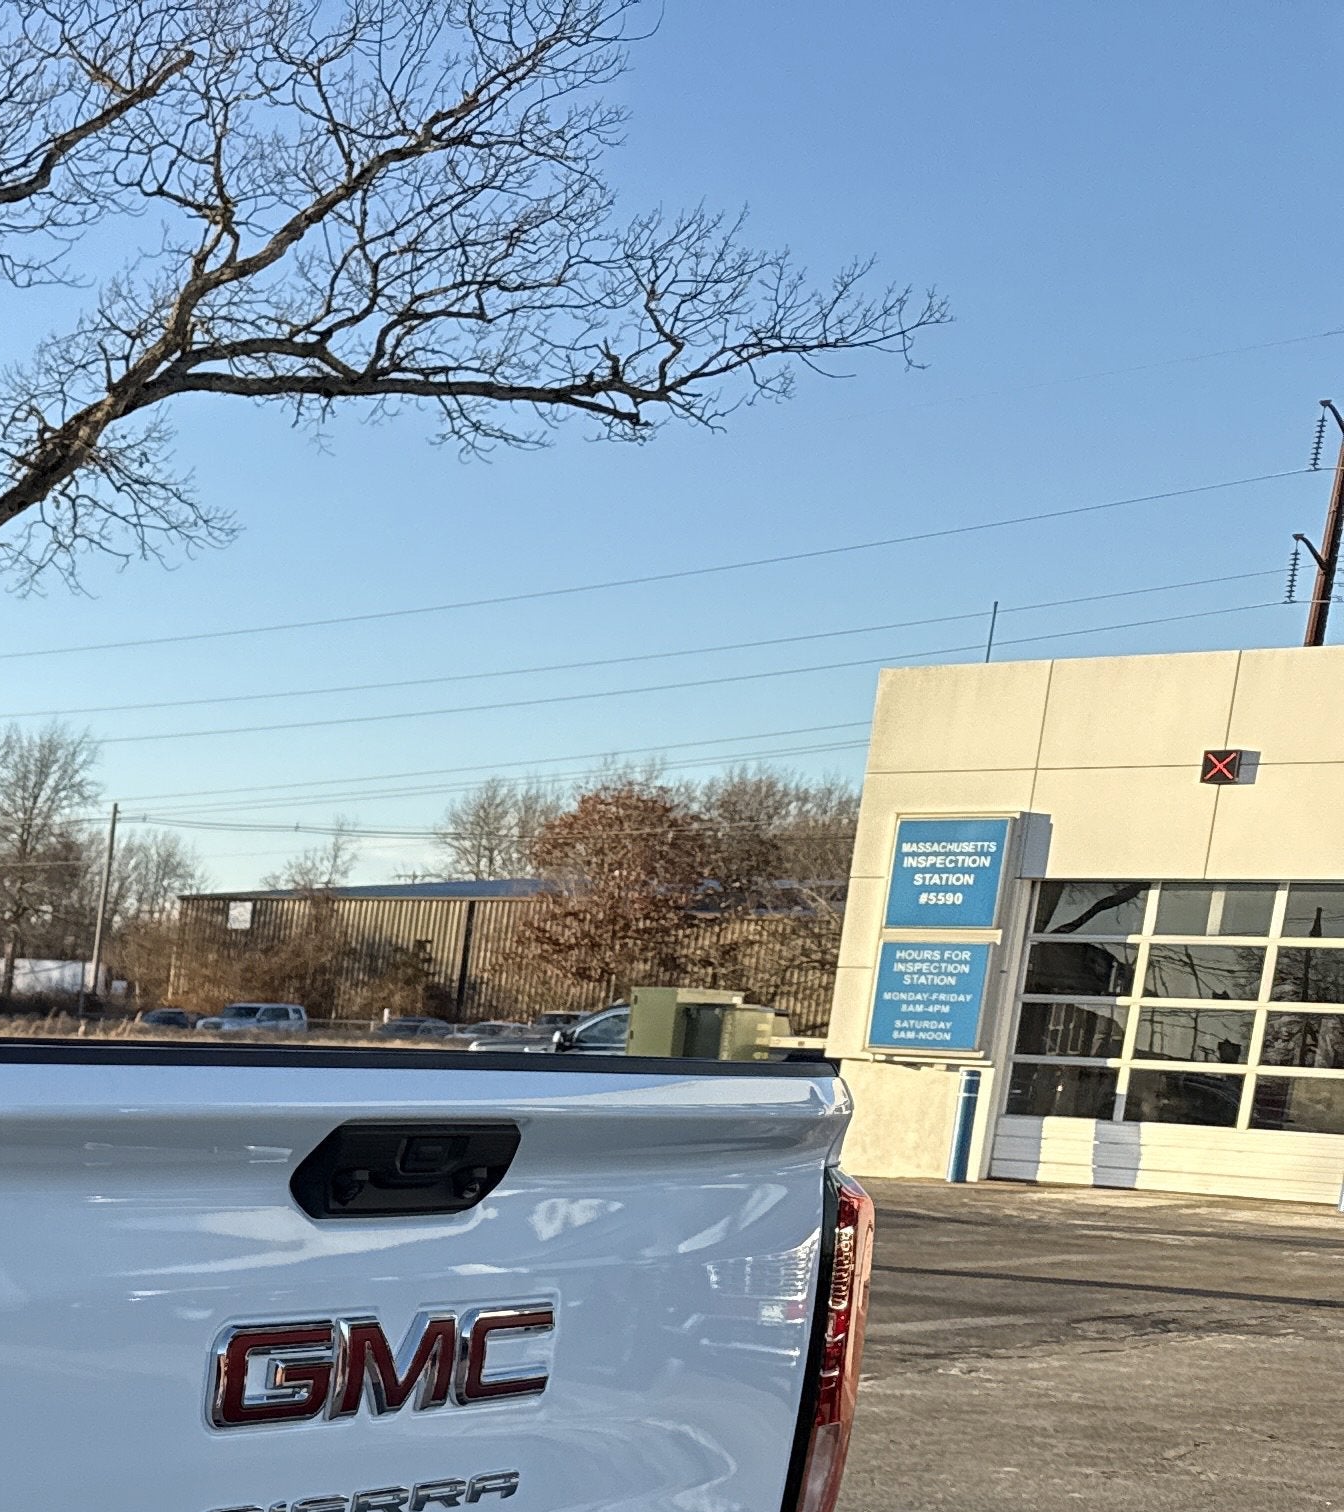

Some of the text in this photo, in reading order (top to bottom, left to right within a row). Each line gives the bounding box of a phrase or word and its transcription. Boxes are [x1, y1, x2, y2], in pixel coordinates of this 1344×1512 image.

[901, 841, 997, 853] MASSACHUSETTS
[902, 855, 992, 868] INSPECTION
[912, 873, 975, 886] STATION
[918, 892, 964, 905] #5590
[895, 949, 972, 961] HOURS FOR
[892, 961, 970, 974] INSPECTION
[902, 974, 957, 986] STATION
[882, 991, 973, 1003] MONDAY-FRIDAY
[894, 1019, 953, 1031] SATURDAY
[212, 1302, 555, 1428] GMC
